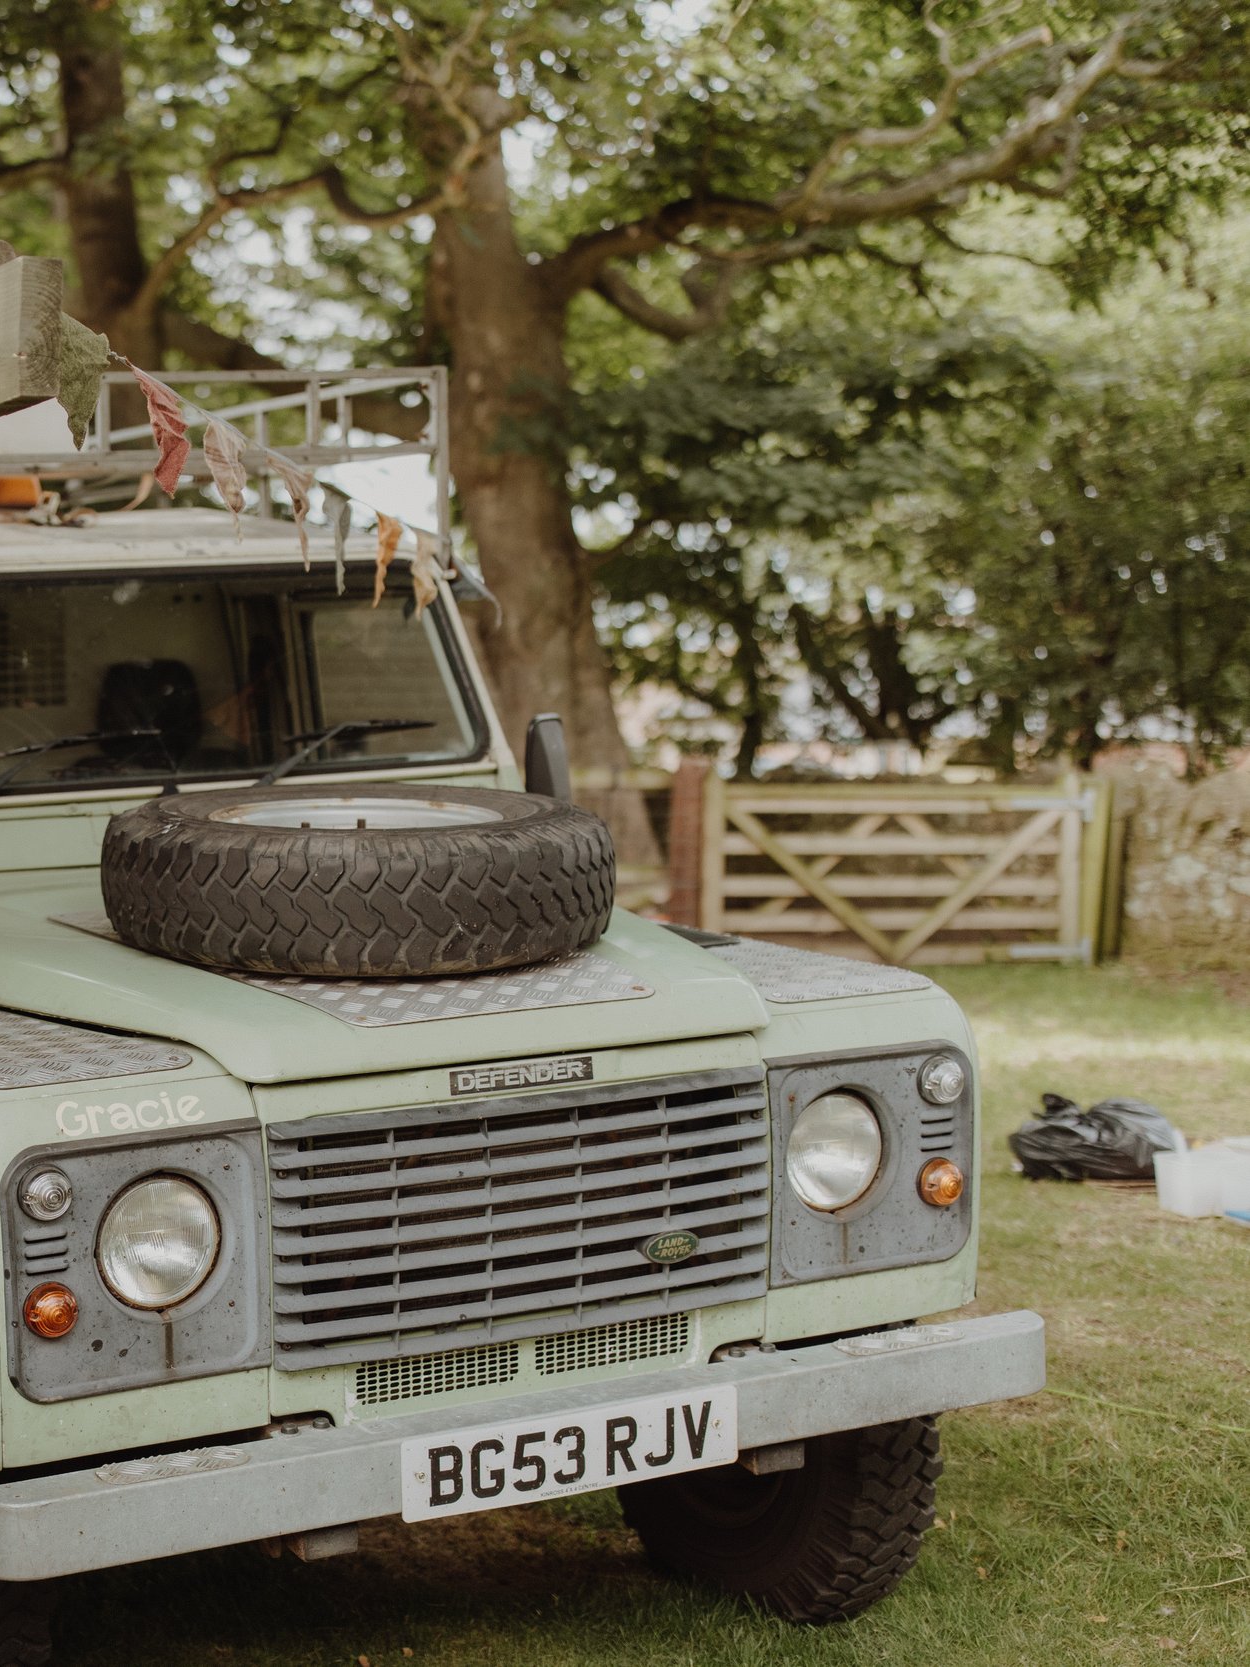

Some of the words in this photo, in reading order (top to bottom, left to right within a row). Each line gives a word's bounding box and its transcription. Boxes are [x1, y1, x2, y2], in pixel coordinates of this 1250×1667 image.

[457, 1061, 585, 1092] DEFENDER
[55, 1091, 206, 1137] Gracie
[658, 1237, 684, 1249] LAND
[660, 1244, 692, 1258] ROVER
[428, 1426, 586, 1507] BG53
[606, 1400, 712, 1477] RJV
